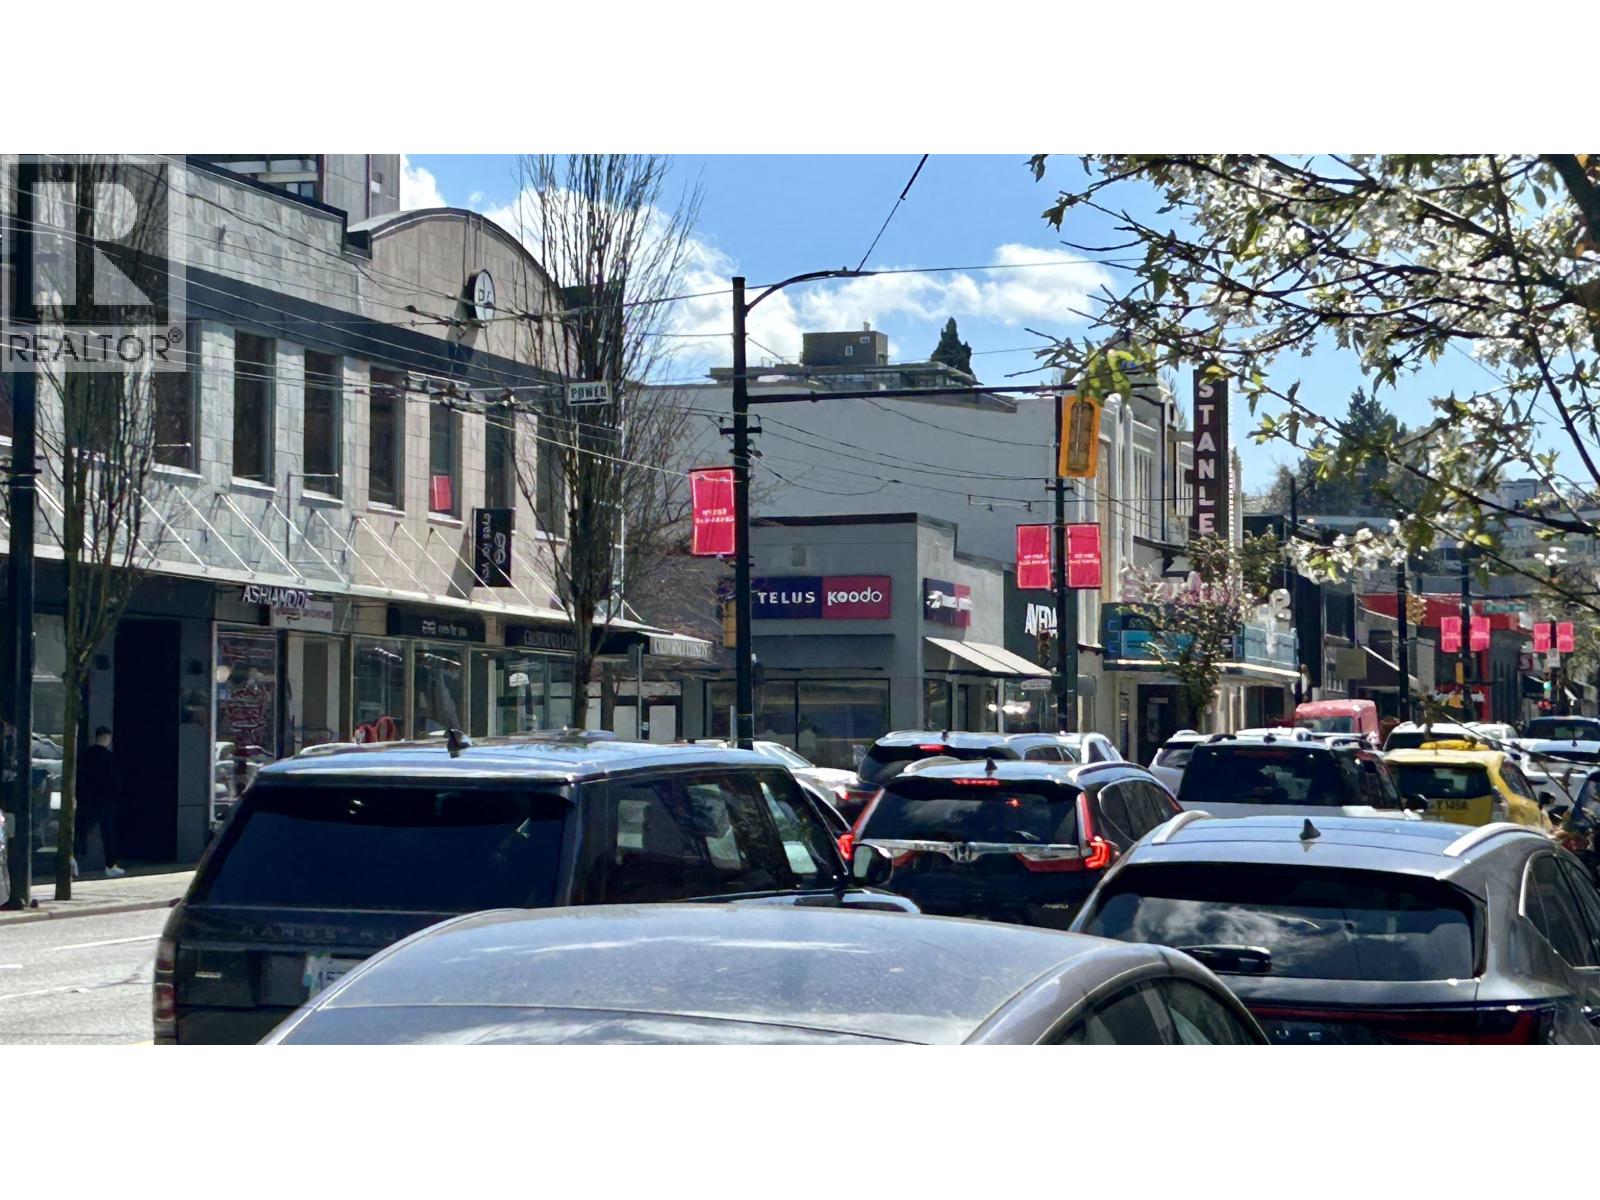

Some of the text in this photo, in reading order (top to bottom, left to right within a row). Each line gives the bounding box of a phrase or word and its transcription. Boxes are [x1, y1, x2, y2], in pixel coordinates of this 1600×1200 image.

[1196, 378, 1217, 535] STANLE
[757, 591, 816, 605] TELUS
[827, 586, 883, 607] koodo
